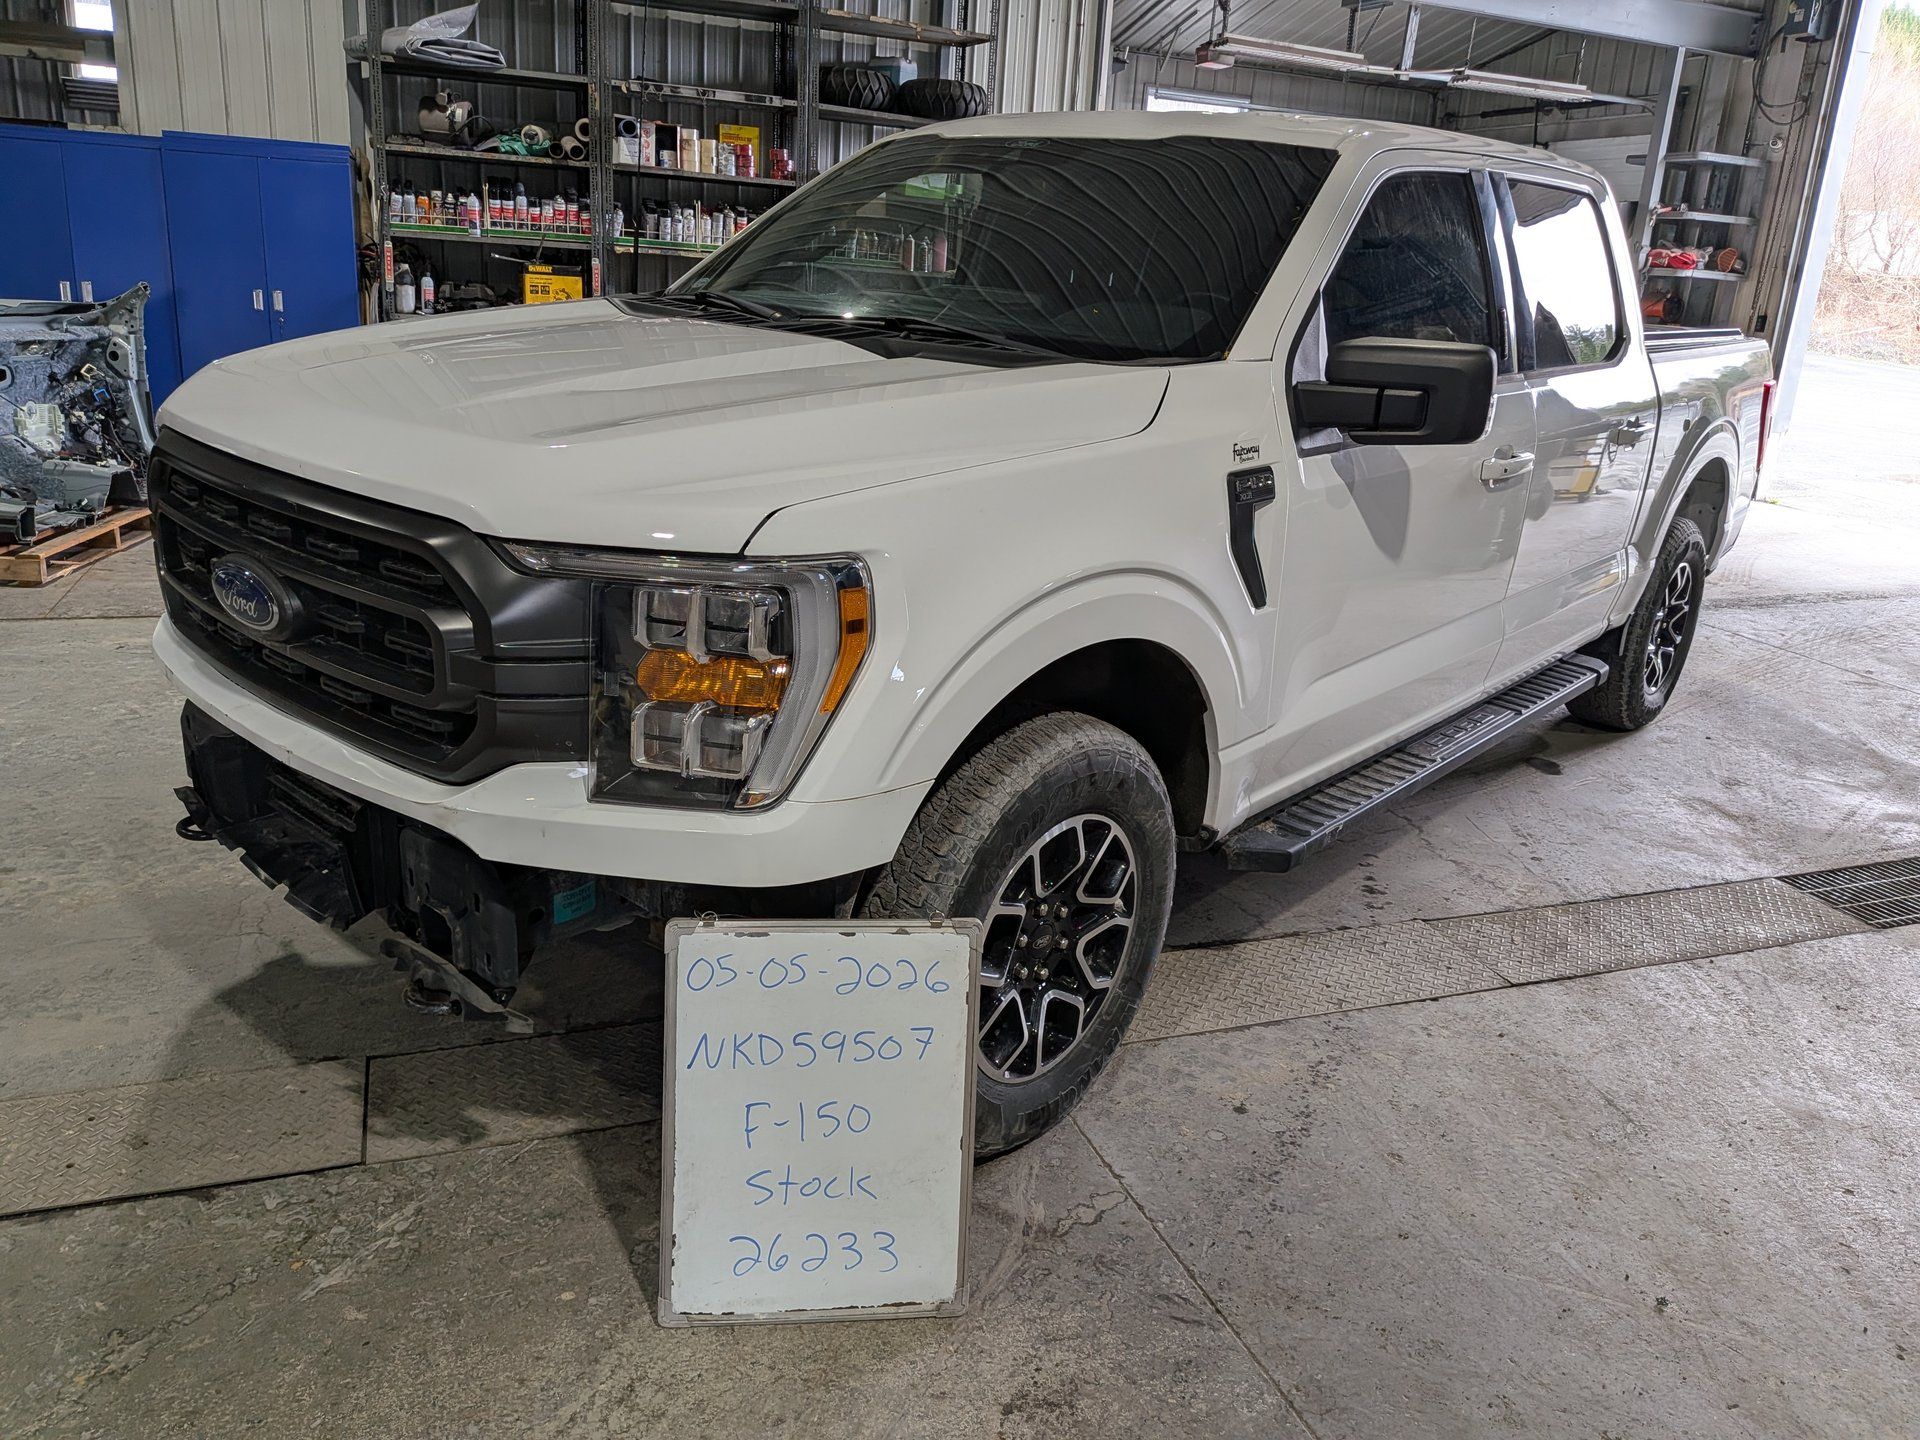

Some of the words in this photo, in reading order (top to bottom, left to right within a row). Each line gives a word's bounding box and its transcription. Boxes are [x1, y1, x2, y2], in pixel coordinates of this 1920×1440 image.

[1233, 443, 1260, 462] Fairway
[222, 576, 259, 618] Ford
[686, 953, 950, 995] 05-05-2026
[686, 1027, 935, 1070] NKD59507
[744, 1101, 872, 1149] F-150
[745, 1164, 878, 1206] Stock
[729, 1230, 899, 1276] 26233
